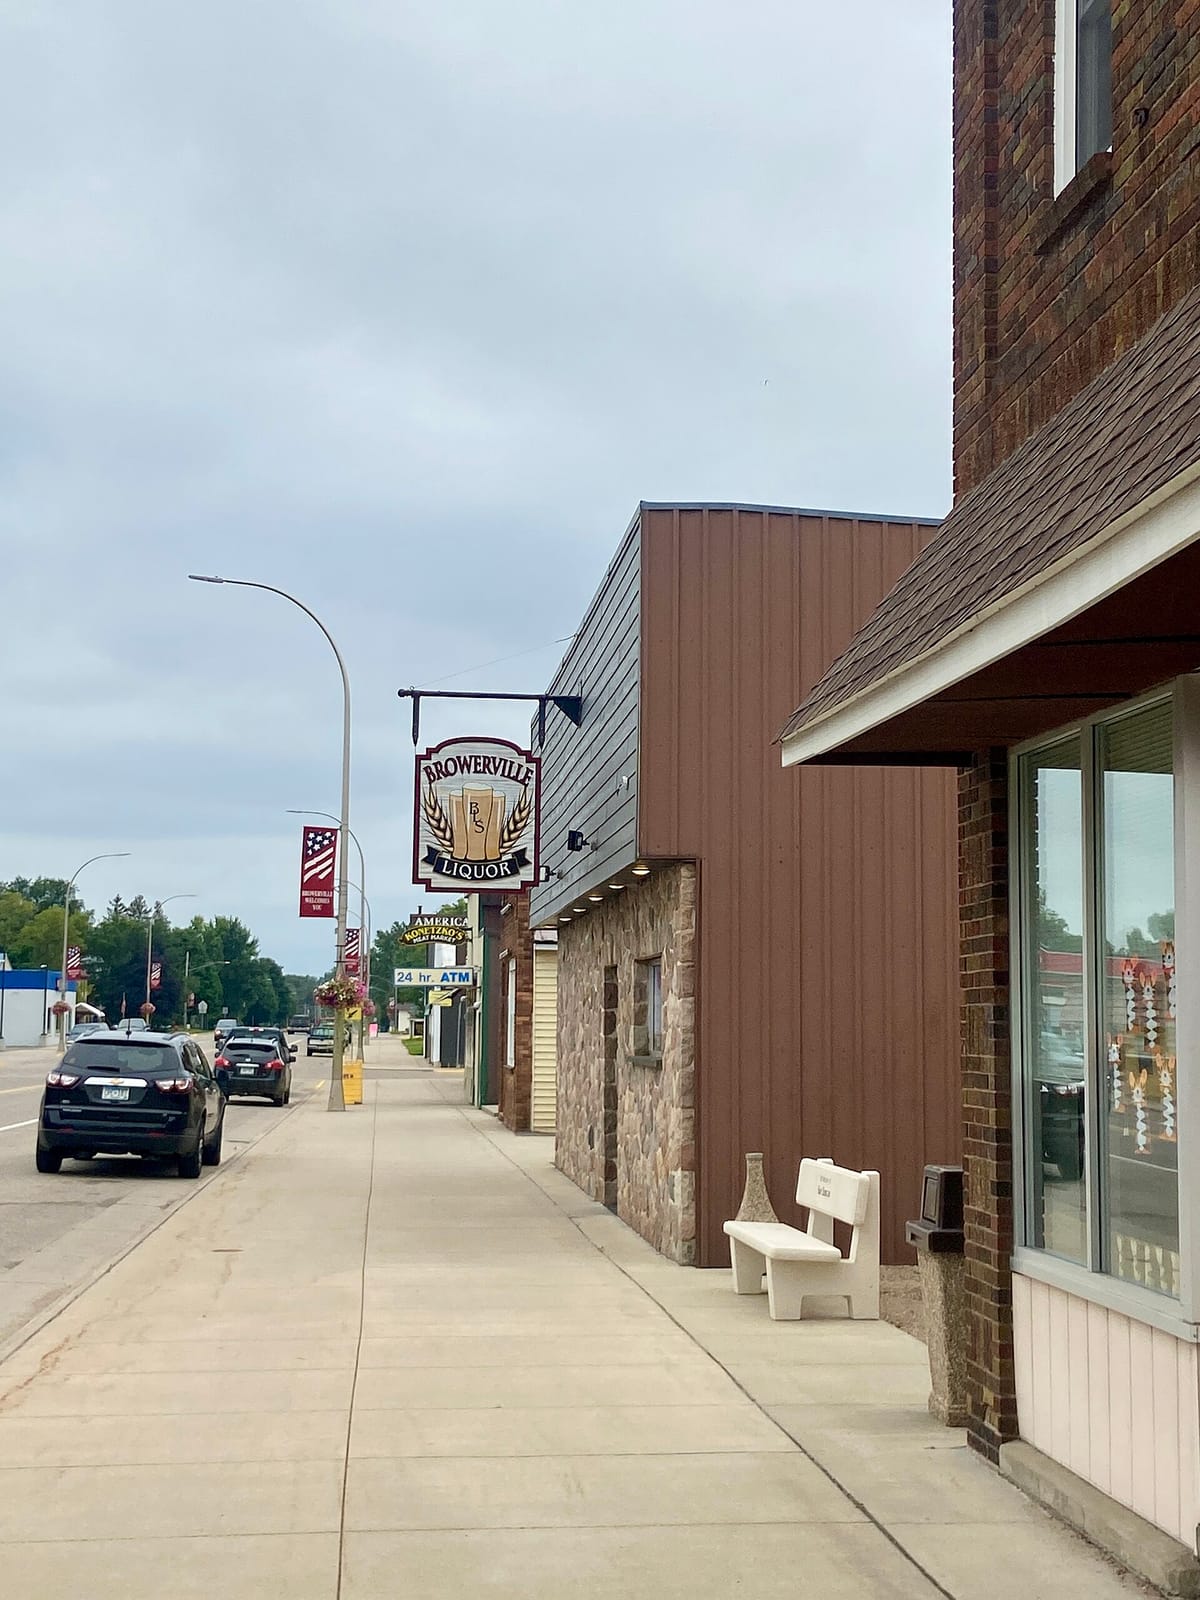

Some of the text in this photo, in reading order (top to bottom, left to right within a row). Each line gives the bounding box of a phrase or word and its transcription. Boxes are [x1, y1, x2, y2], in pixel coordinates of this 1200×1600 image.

[423, 755, 534, 785] BROWERVILLE
[442, 859, 511, 880] LIQUOR
[404, 926, 464, 941] KONETZKO'S
[413, 934, 456, 943] MEAT MARKET
[397, 971, 469, 983] 24 hr. ATM
